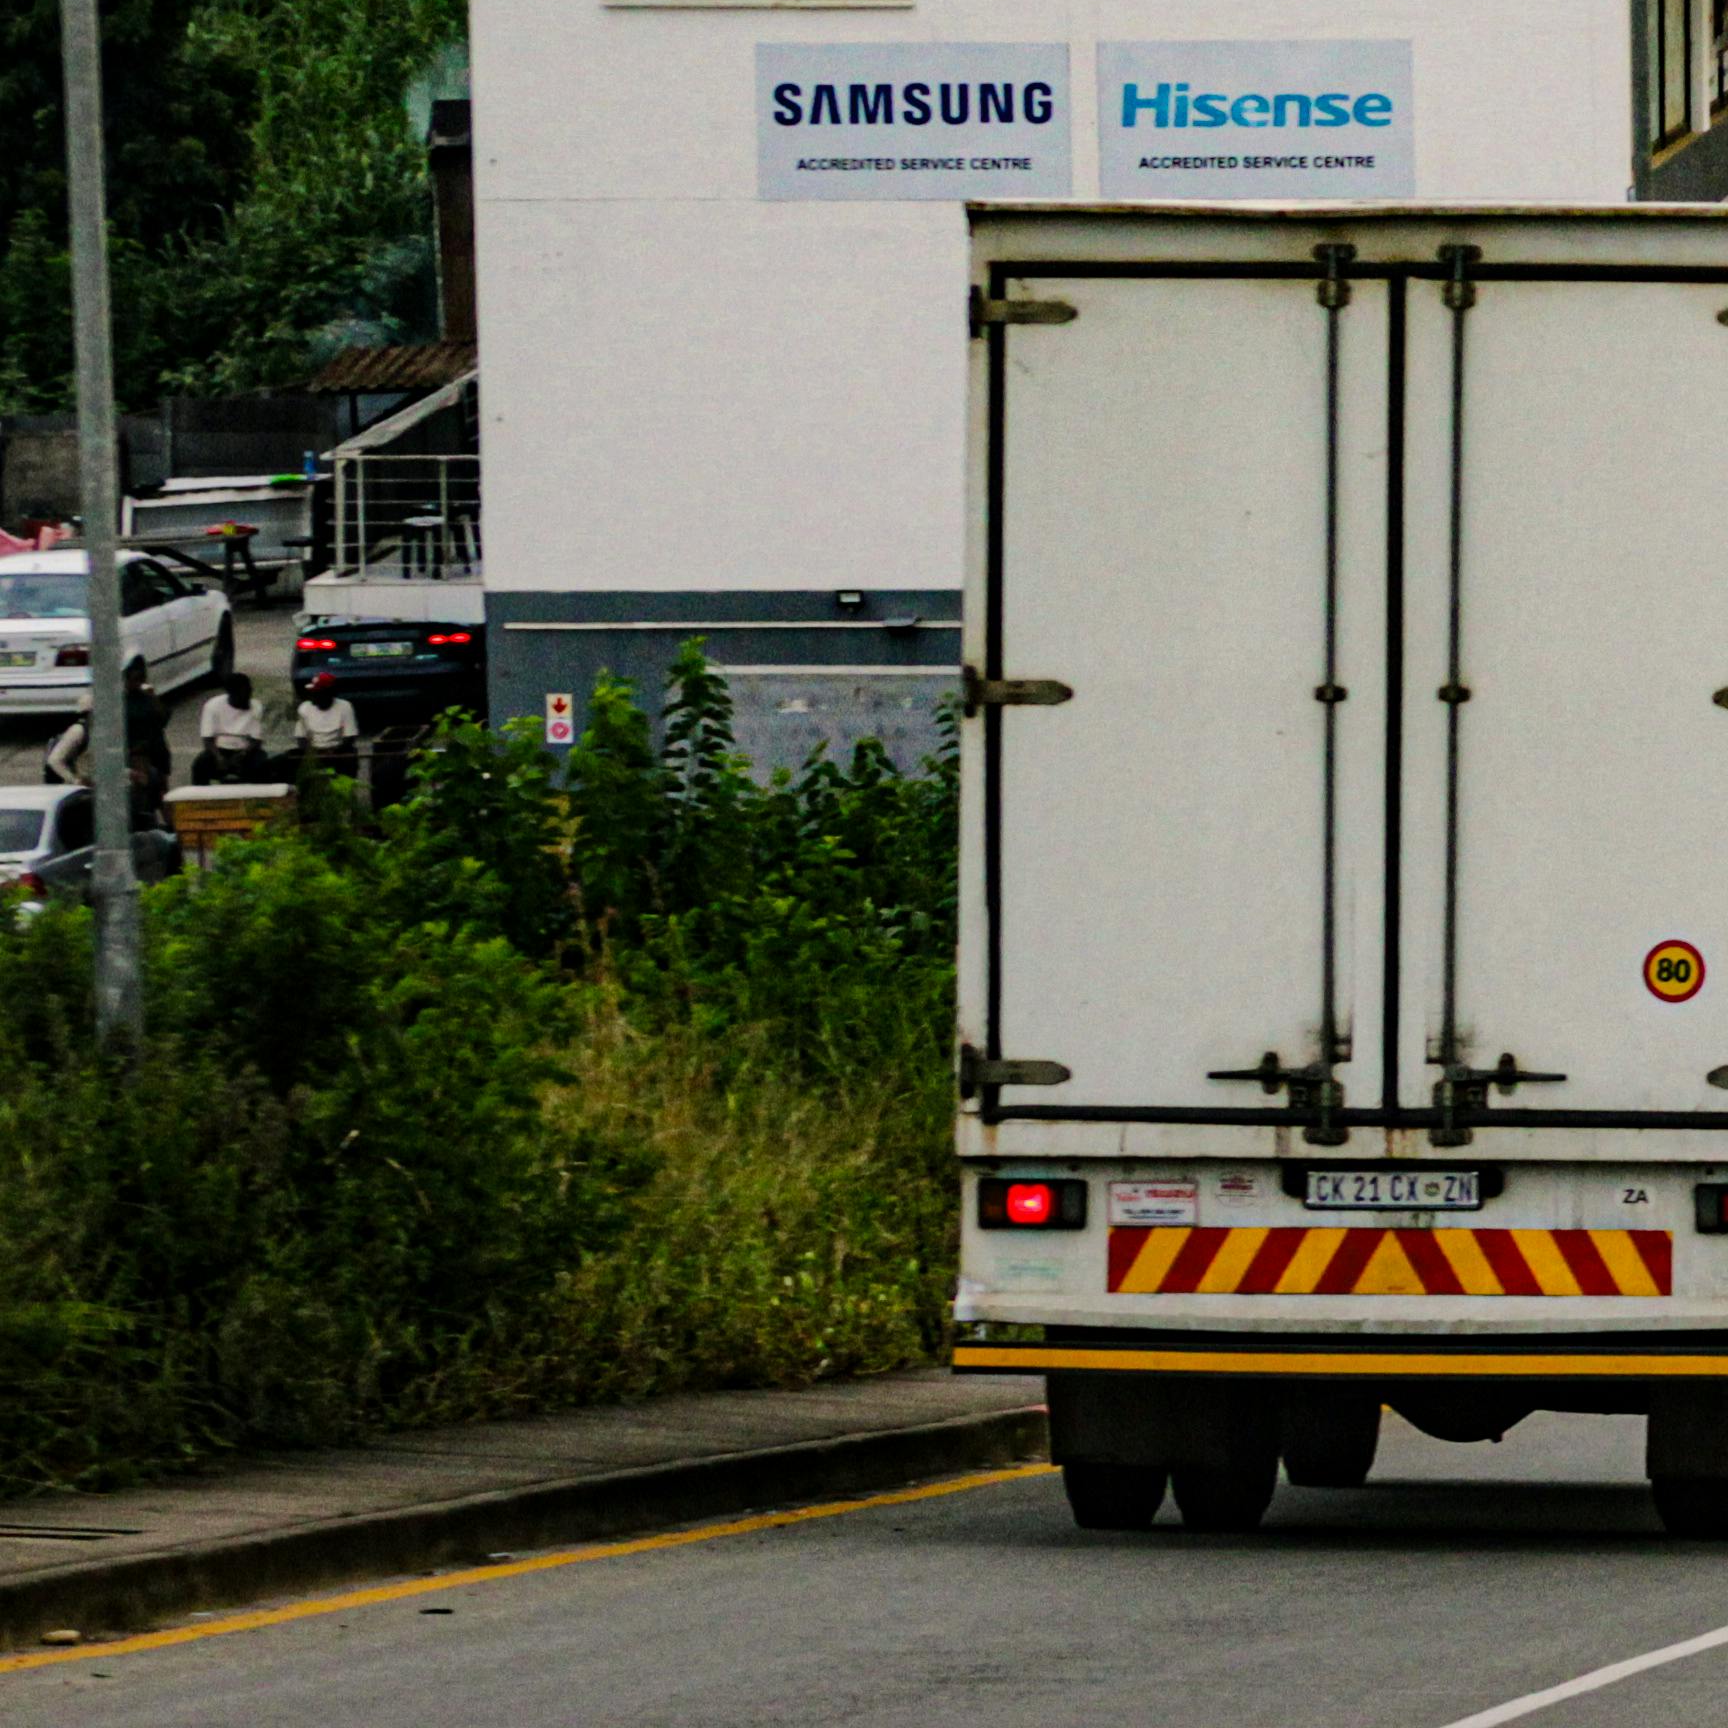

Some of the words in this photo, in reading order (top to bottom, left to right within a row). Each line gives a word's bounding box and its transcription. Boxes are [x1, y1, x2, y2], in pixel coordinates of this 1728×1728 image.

[773, 81, 1054, 127] SAMSUNG
[1121, 81, 1394, 129] Hisense
[796, 157, 896, 171] ACCREDITED
[899, 157, 965, 171] SERVICE
[969, 157, 1032, 171] CENTRE
[1138, 155, 1237, 170] ACCREDITED
[1241, 155, 1307, 170] SERVICE
[1312, 155, 1375, 169] CENTRE
[1656, 957, 1692, 984] 80
[1316, 1175, 1344, 1202] CK
[1354, 1176, 1381, 1202] 21
[1390, 1176, 1419, 1202] CX
[1444, 1176, 1473, 1202] ZN
[1622, 1188, 1650, 1204] ZA
